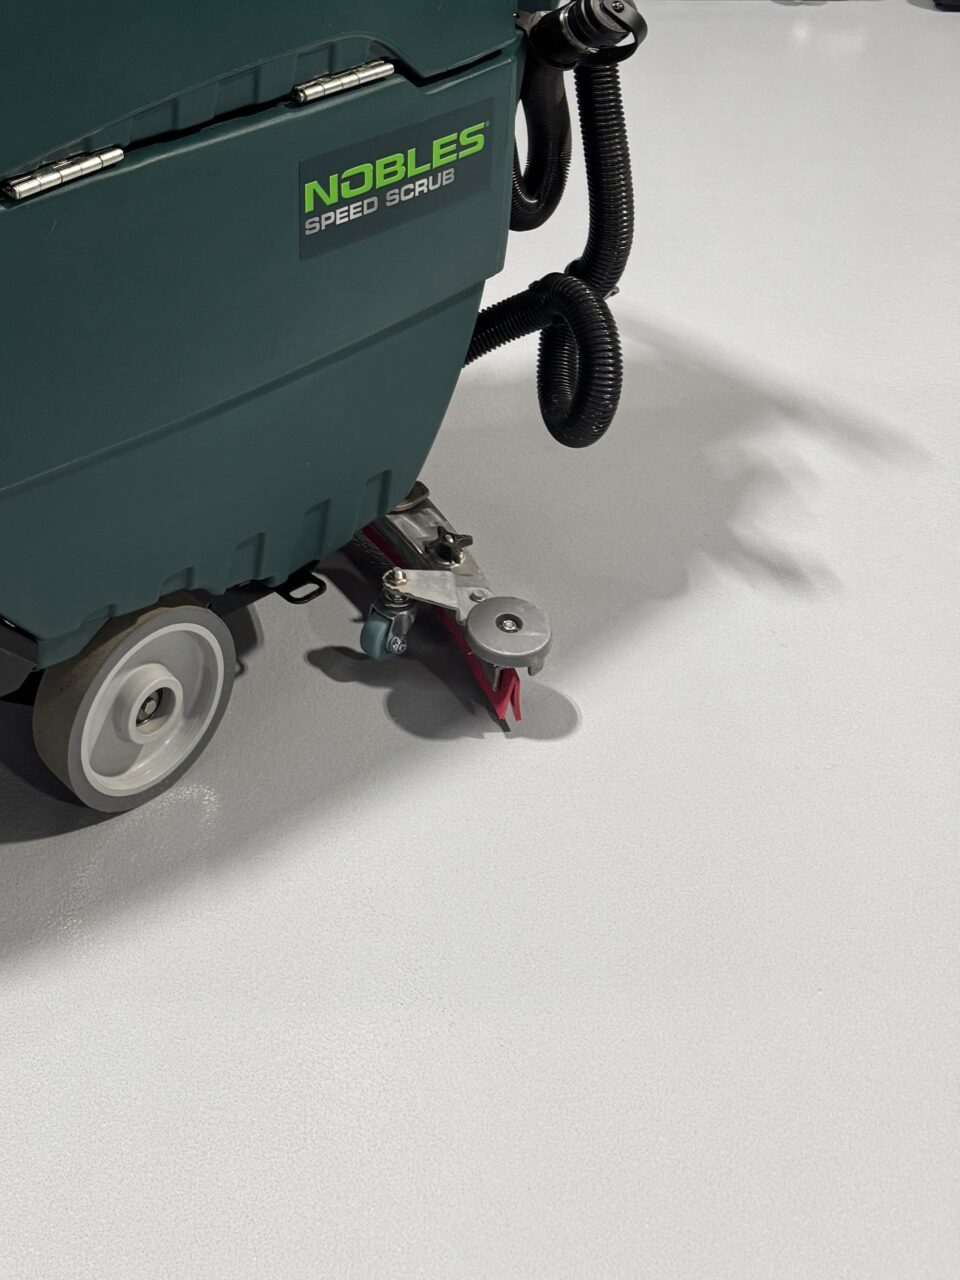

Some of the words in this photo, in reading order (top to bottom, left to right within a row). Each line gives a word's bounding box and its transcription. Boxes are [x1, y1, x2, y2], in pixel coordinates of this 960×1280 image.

[304, 122, 486, 214] NOBLES
[304, 196, 379, 236] SPEED
[386, 167, 456, 208] SCRUB
